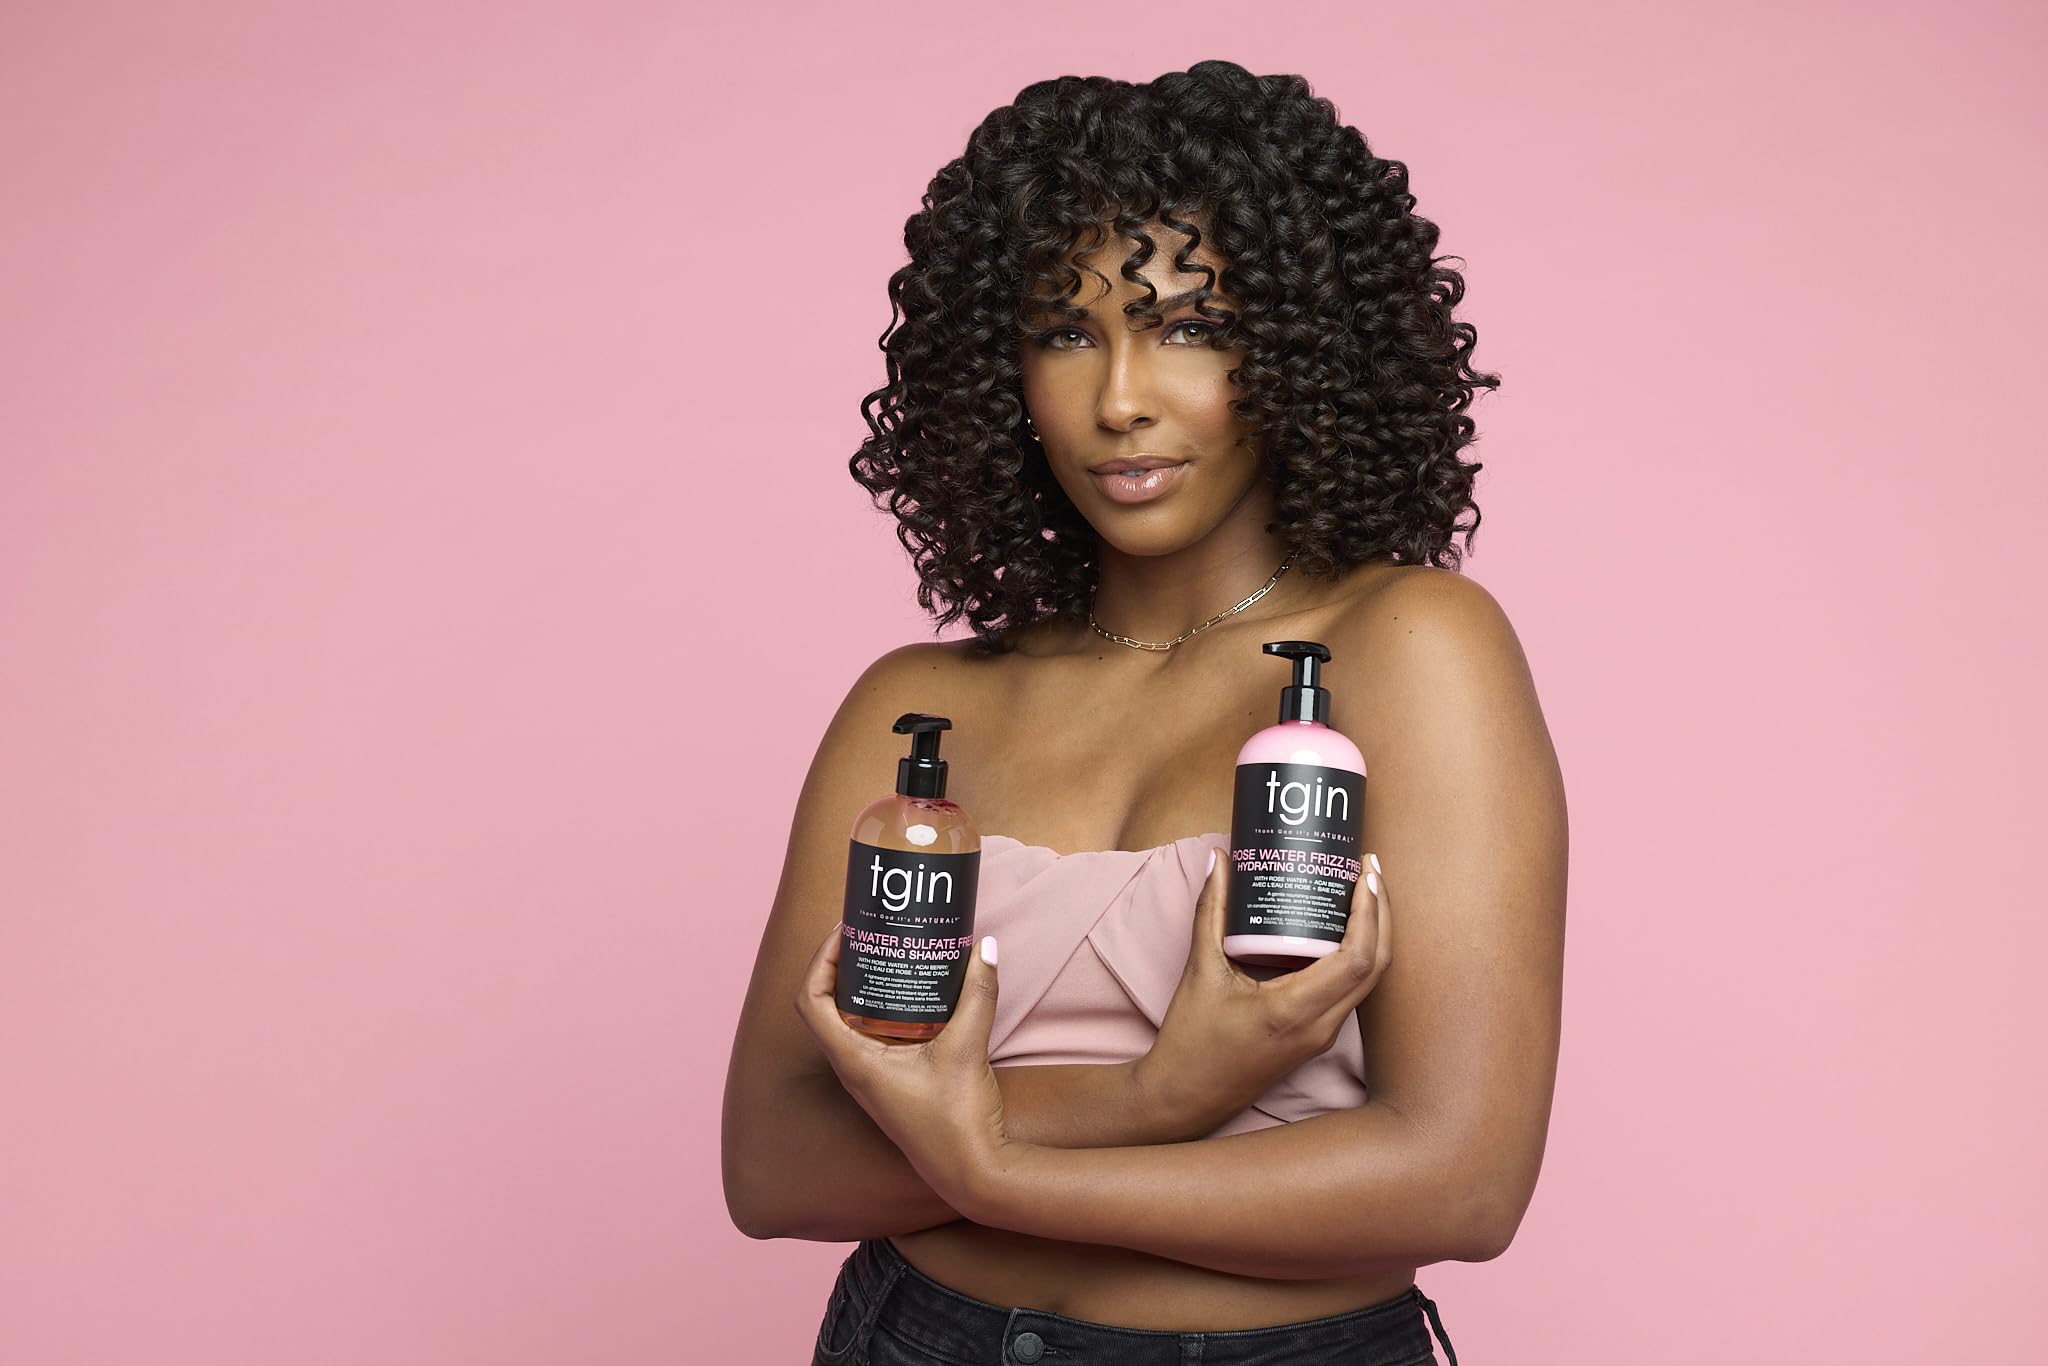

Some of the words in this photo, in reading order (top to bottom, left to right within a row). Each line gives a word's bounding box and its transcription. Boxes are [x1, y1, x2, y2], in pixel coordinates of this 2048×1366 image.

[1266, 770, 1349, 826] tgin
[1232, 849, 1256, 862] ROSE
[1260, 849, 1307, 863] WATER
[1310, 852, 1346, 868] FRIZZ
[1346, 858, 1361, 874] FRE
[1237, 861, 1294, 873] HYDRATING
[1297, 863, 1359, 883] CONDITIONE
[870, 854, 953, 912] tgin
[1249, 916, 1263, 924] NO
[849, 939, 906, 959] HYDRATING
[908, 949, 960, 961] SHAMPOO
[857, 929, 899, 947] WATER
[902, 937, 956, 950] SULFATE
[856, 962, 869, 970] AVEC
[871, 959, 887, 967] ROSE
[887, 961, 909, 969] WATER
